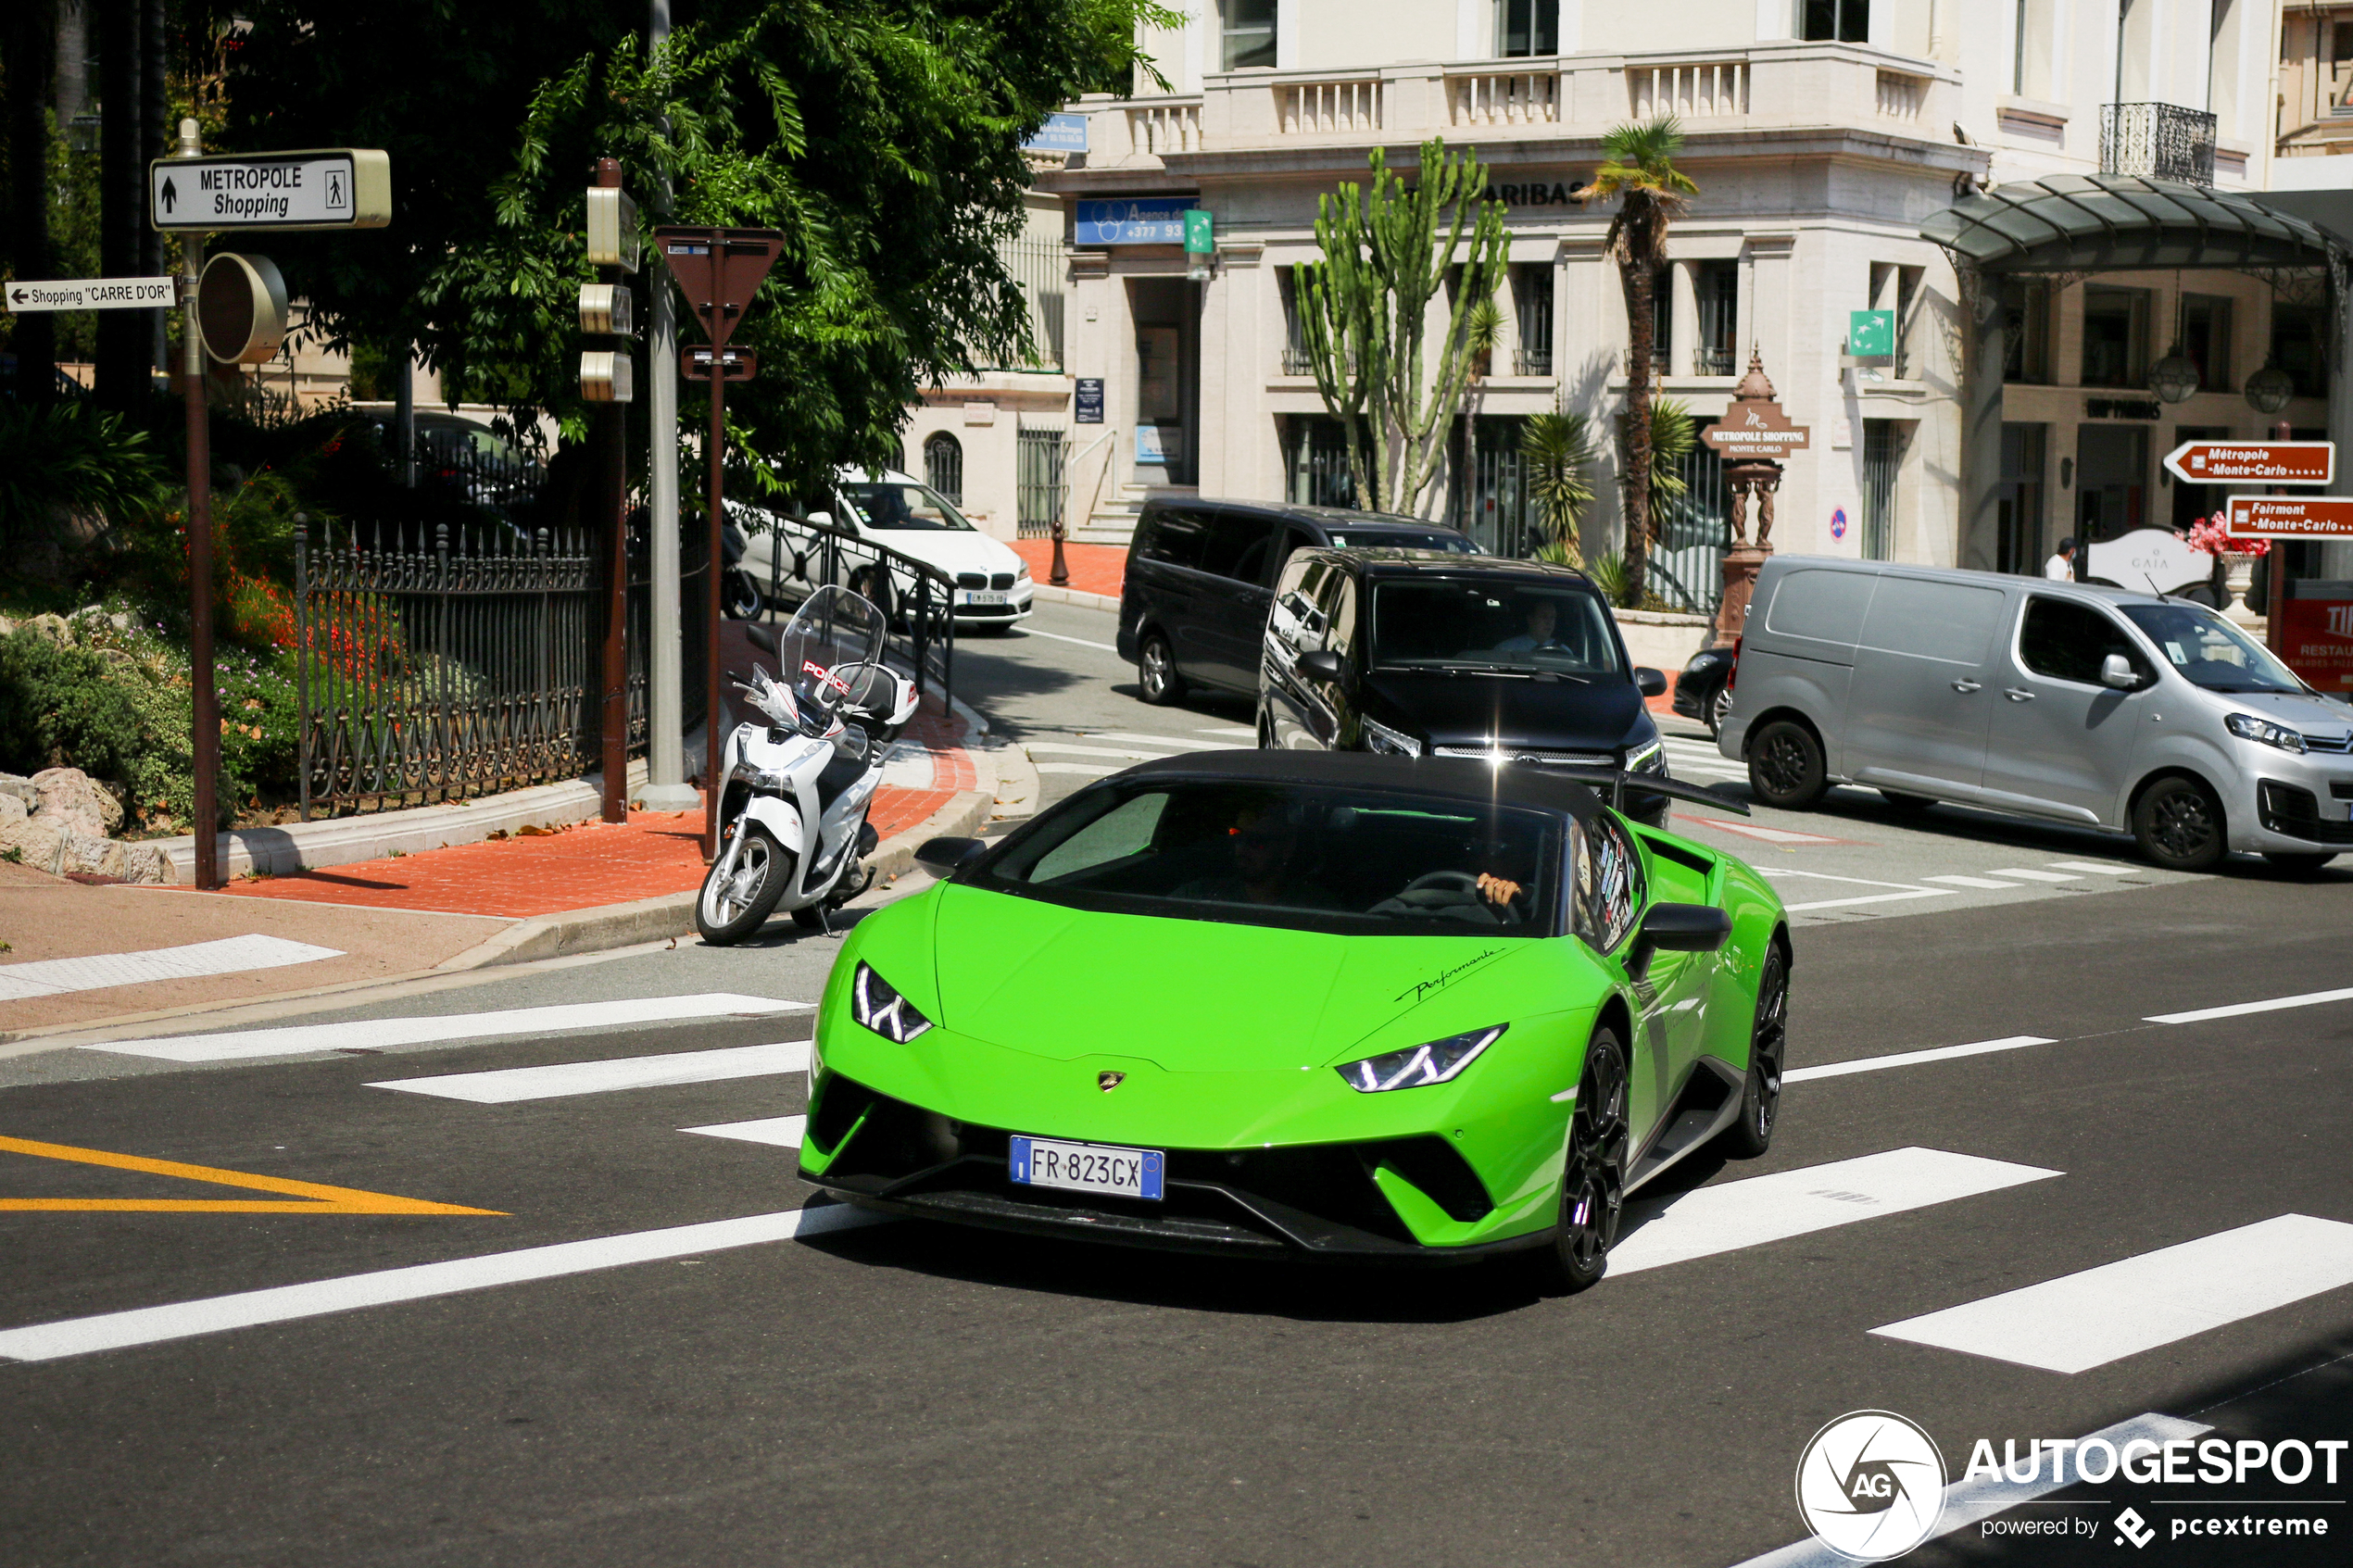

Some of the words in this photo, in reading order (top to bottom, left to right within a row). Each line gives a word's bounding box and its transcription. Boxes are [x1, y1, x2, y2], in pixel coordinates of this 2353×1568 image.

[200, 167, 302, 191] METROPOLE
[214, 193, 289, 218] Shopping
[1128, 203, 1170, 224] Agence
[1126, 226, 1156, 237] +377
[31, 289, 83, 306] Shopping
[85, 286, 133, 302] "CARRE
[136, 284, 171, 300] D'OR"
[1712, 431, 1760, 443] METROPOLE
[1762, 432, 1805, 443] SHOPPING
[1729, 445, 1755, 453] MONTE
[1756, 445, 1782, 454] CARLO
[2208, 448, 2270, 462] Métropole
[2251, 502, 2306, 515] Fairmont
[802, 660, 850, 696] POLICE
[1394, 947, 1506, 1002] Performante
